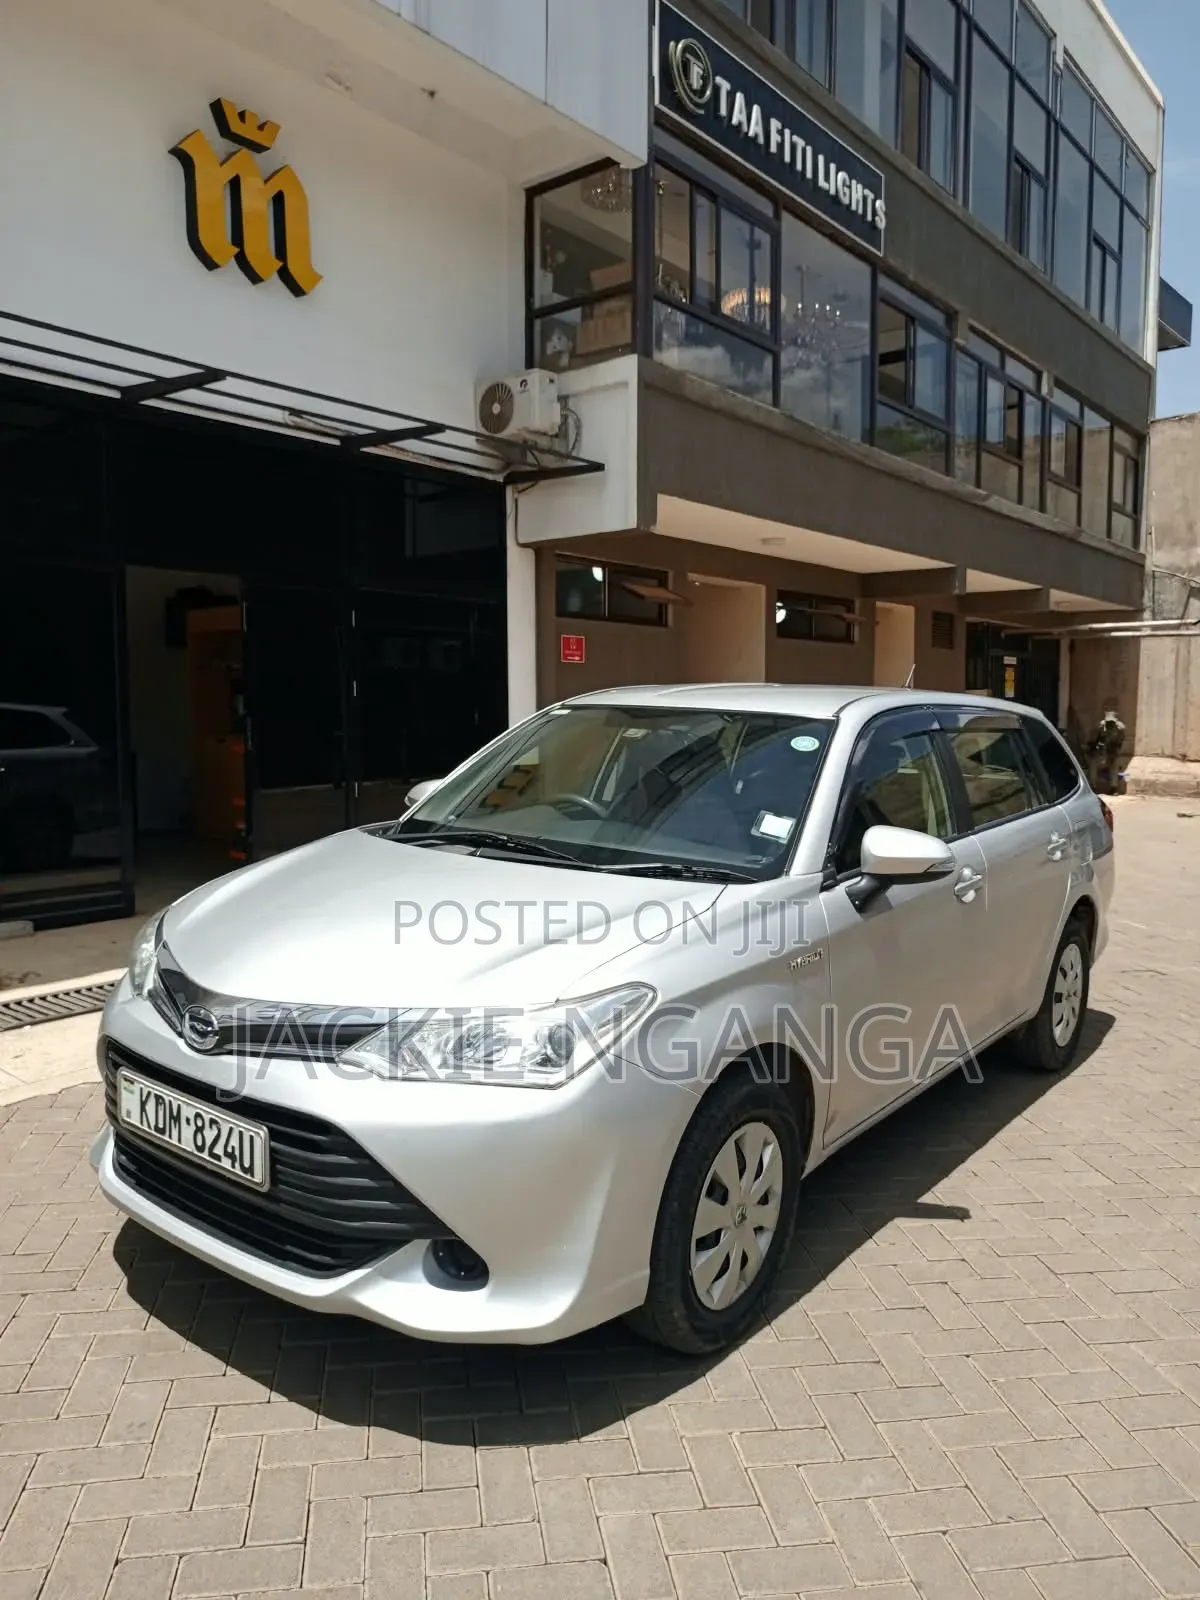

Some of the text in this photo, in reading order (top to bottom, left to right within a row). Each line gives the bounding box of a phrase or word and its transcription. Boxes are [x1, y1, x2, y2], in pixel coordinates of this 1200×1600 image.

[714, 75, 887, 231] TAA FITI LIGHTS
